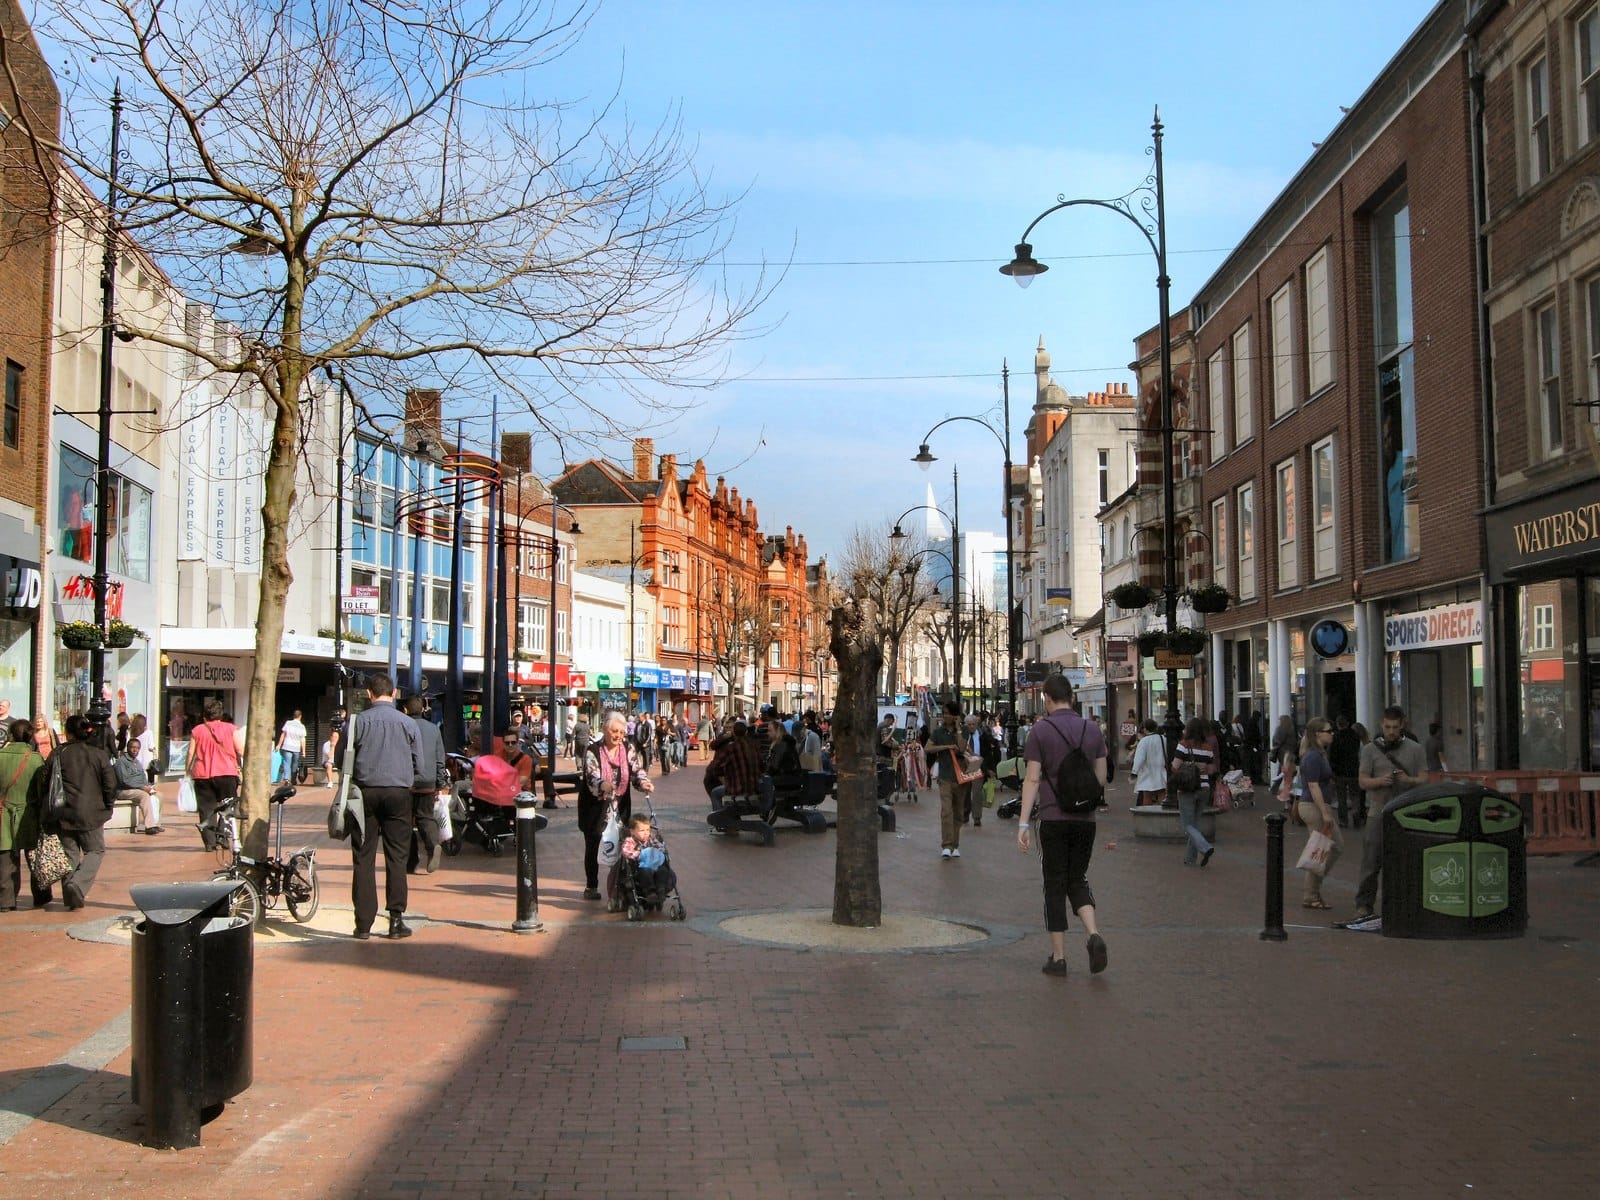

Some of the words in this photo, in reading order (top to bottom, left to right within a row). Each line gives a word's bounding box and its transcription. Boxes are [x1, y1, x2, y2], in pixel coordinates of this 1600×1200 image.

[218, 405, 227, 476] OPTICAL
[186, 477, 195, 552] EXPRESS
[216, 488, 224, 560] EXPRESS
[244, 496, 252, 565] EXPRESS
[343, 601, 353, 609] TO
[172, 659, 202, 684] Optical
[204, 661, 236, 685] Express
